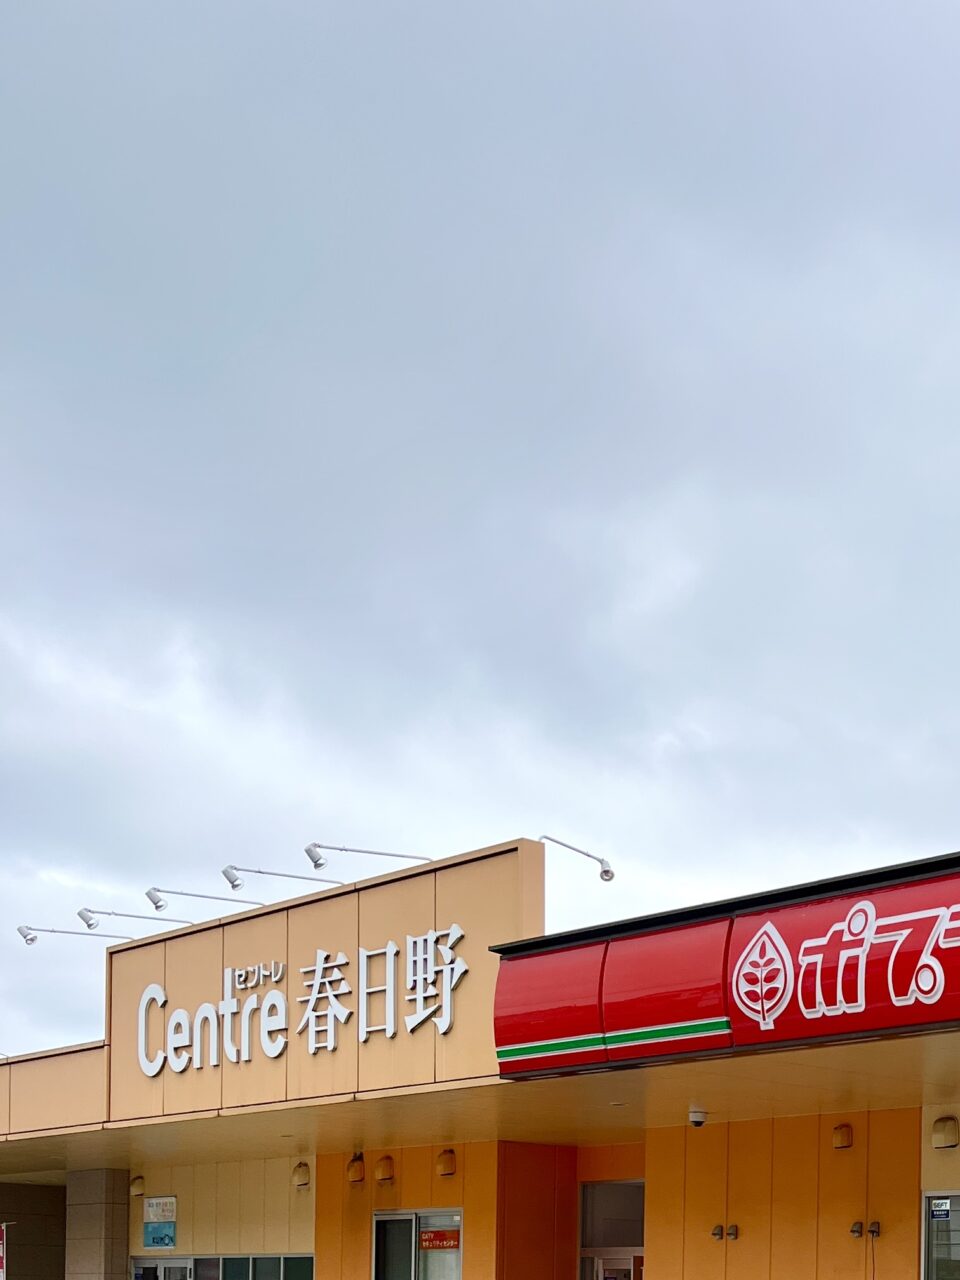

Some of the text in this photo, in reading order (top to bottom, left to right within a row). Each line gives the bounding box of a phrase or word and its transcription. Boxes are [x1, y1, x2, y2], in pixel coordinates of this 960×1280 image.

[138, 924, 469, 1077] Centre 春日野
[235, 961, 287, 989] セントレ
